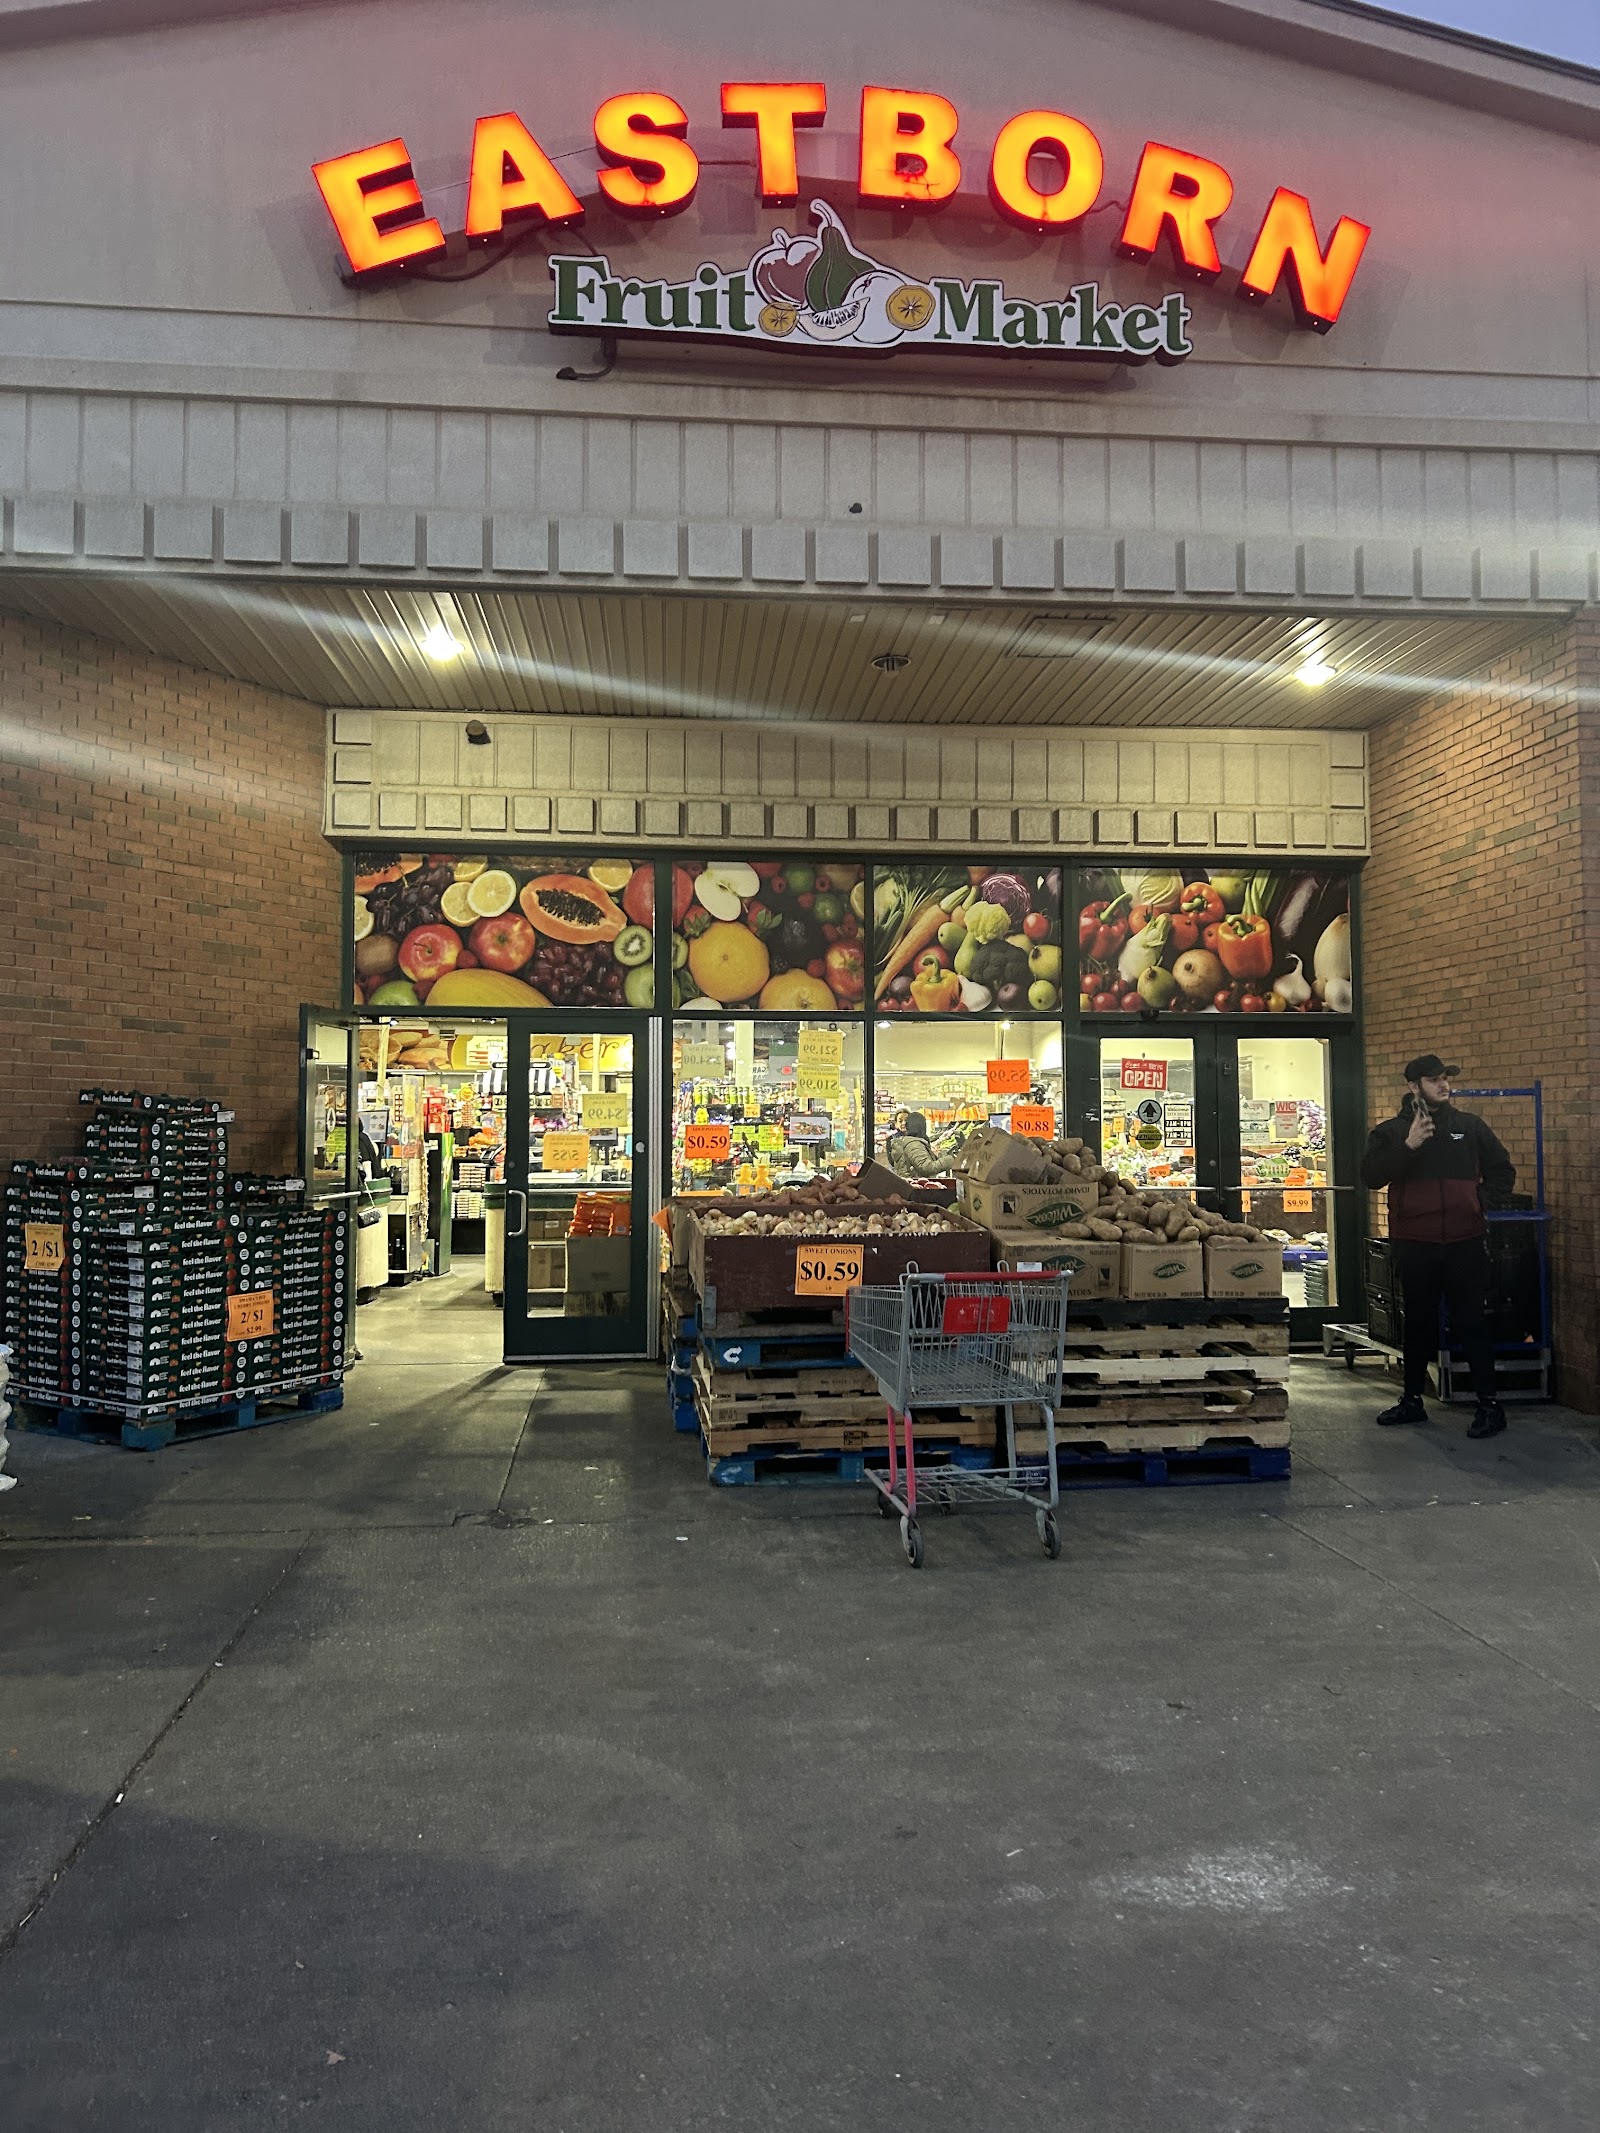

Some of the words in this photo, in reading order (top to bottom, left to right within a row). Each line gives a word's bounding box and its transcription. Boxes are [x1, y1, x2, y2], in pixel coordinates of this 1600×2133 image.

[311, 83, 1372, 323] EASTBORN
[552, 258, 757, 332] Fruit
[934, 281, 1192, 352] Market
[1124, 1069, 1163, 1088] OPEN
[1276, 1101, 1297, 1111] WIC
[1016, 1120, 1049, 1132] $0.88
[687, 1135, 728, 1149] $0.59
[1022, 1187, 1063, 1195] POTATOES
[1065, 1186, 1090, 1194] IDAHO
[1287, 1200, 1309, 1208] $9.99
[1034, 1204, 1075, 1224] Wilcox
[31, 1240, 38, 1256] 2
[800, 1261, 859, 1281] $0.59
[240, 1311, 251, 1324] 2/
[253, 1309, 263, 1322] $1
